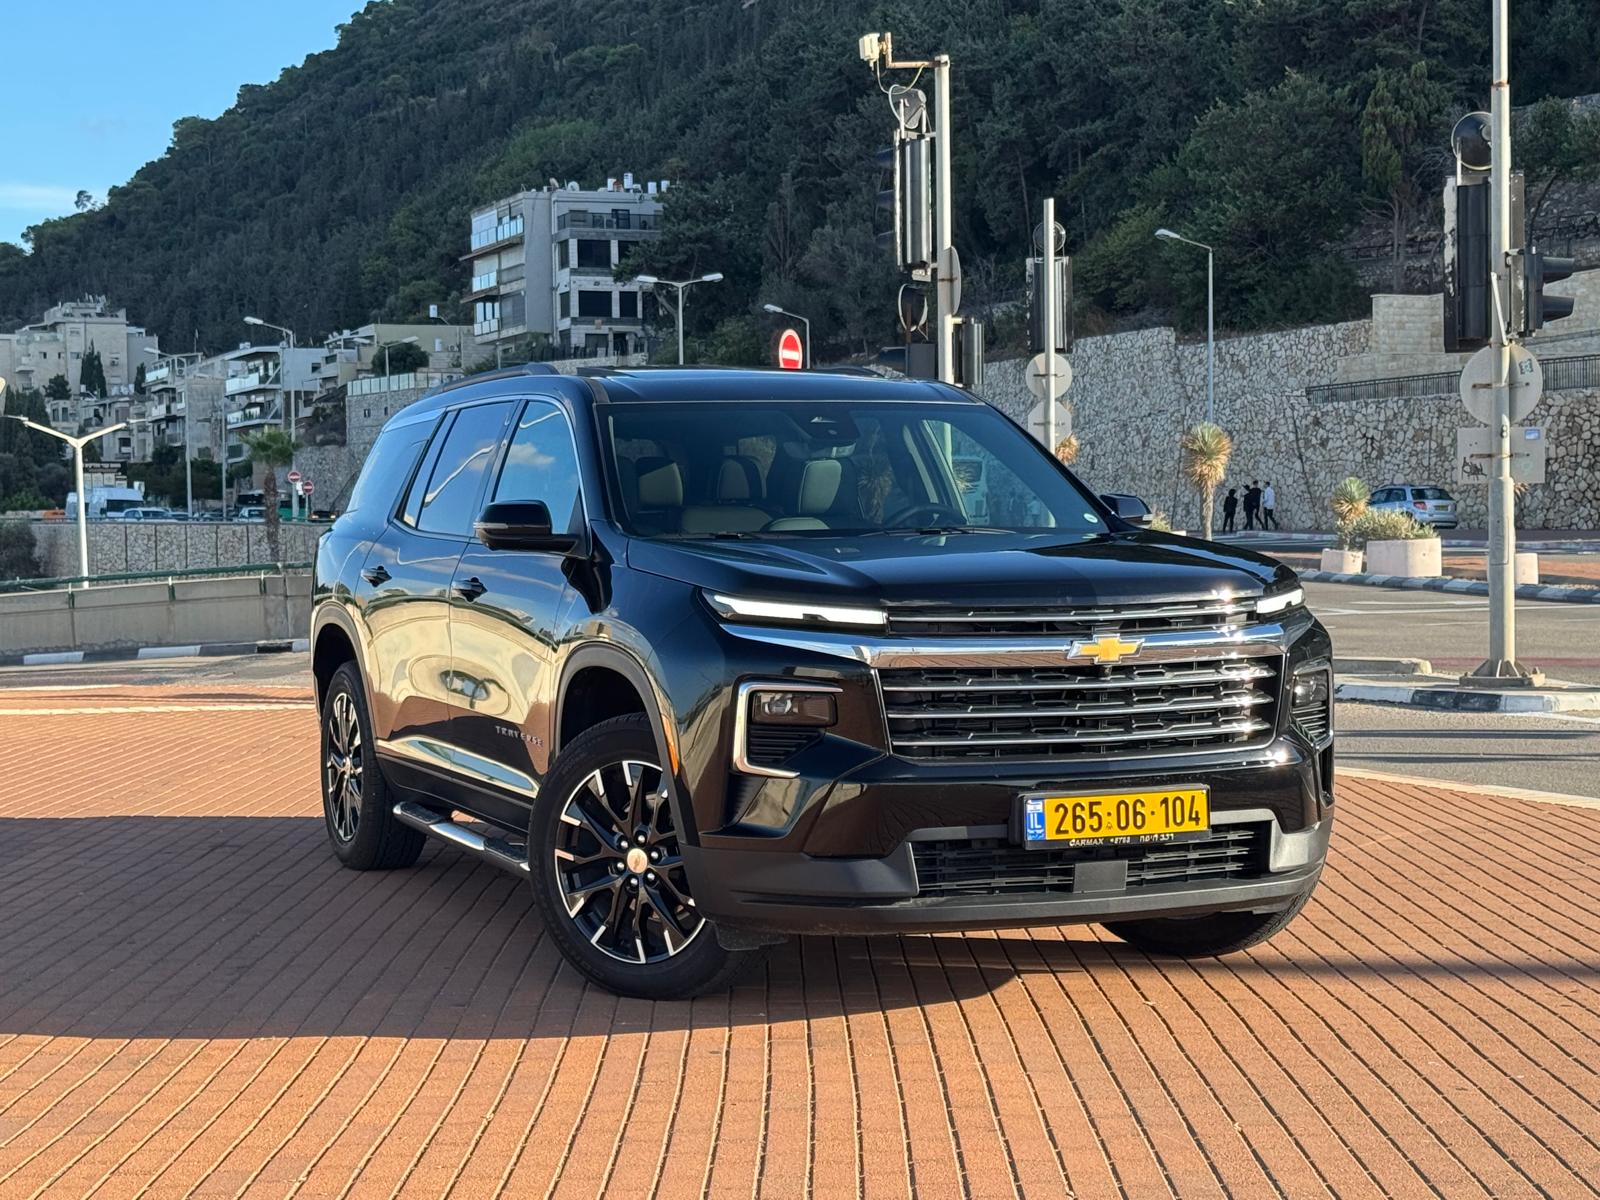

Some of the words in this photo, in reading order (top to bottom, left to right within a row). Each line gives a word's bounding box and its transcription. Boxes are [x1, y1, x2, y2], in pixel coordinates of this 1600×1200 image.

[495, 725, 545, 747] TRAVERSE
[1030, 813, 1042, 829] IL
[1069, 837, 1104, 847] CARMAX
